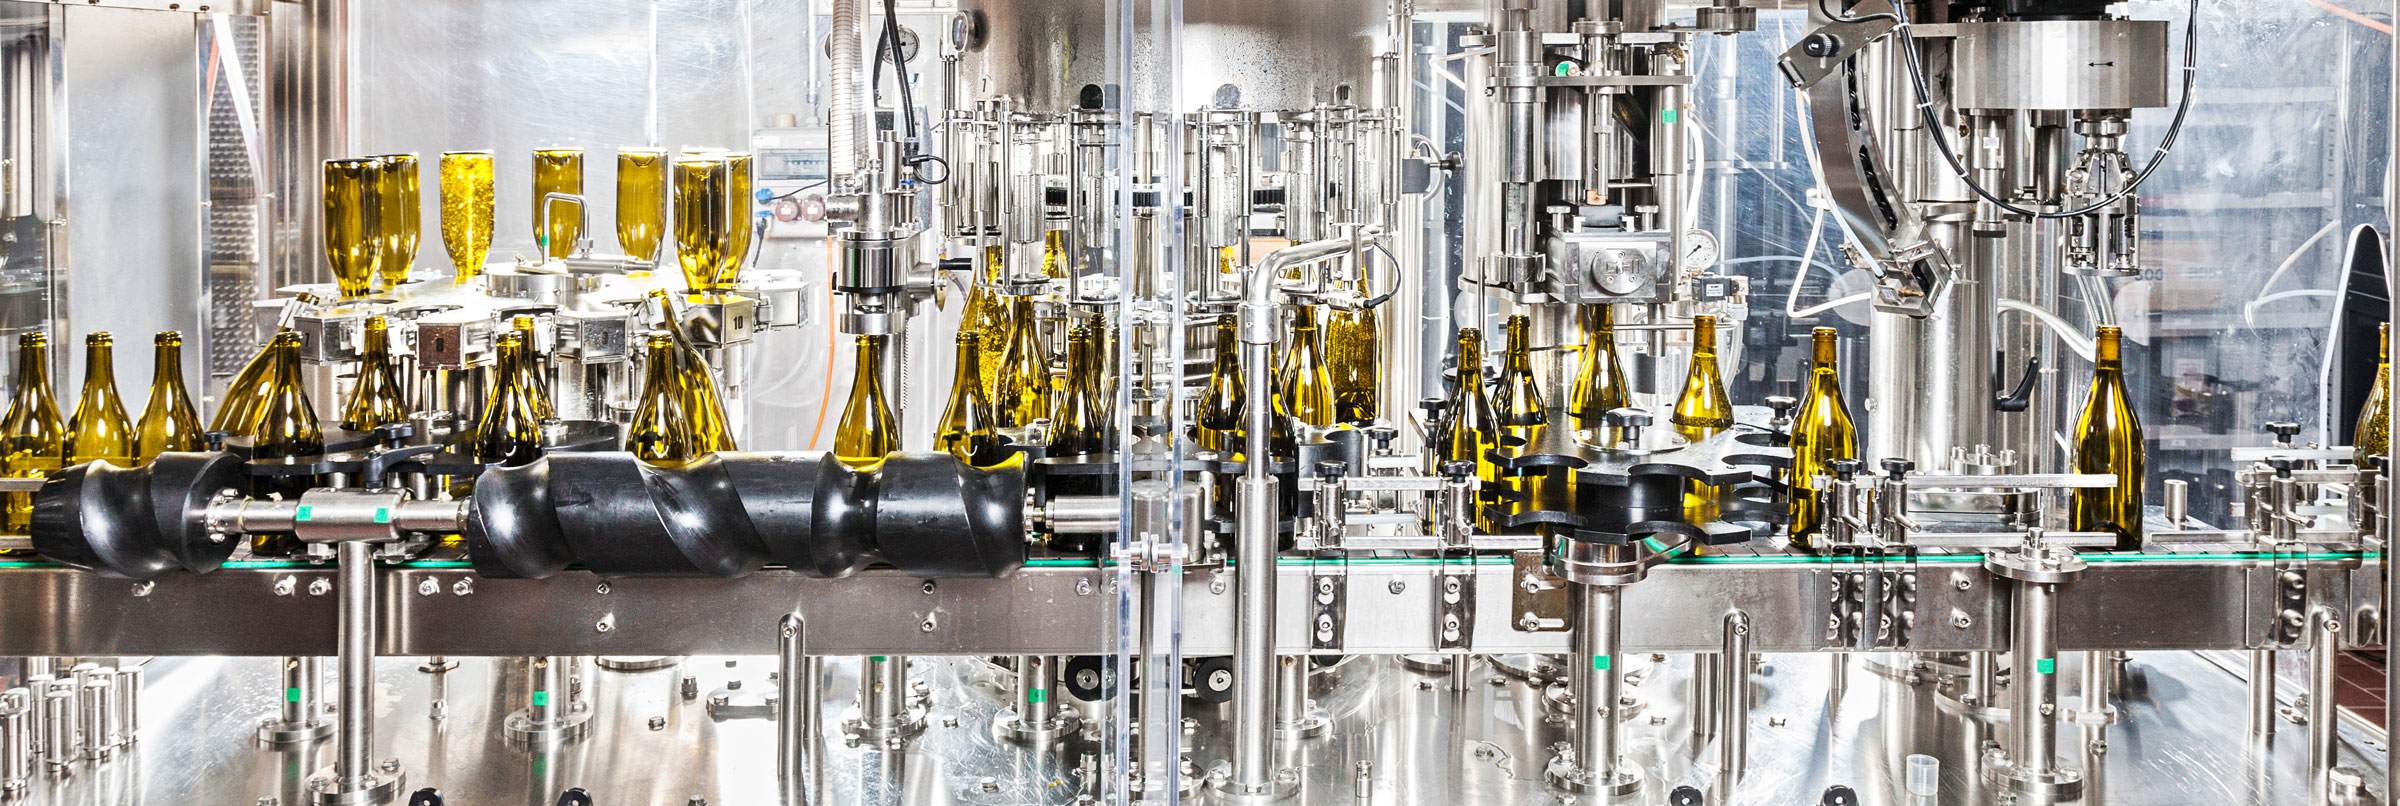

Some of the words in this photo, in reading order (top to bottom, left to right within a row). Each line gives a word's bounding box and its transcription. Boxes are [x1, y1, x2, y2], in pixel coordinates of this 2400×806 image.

[982, 78, 987, 92] 7
[1339, 85, 1349, 101] 10
[733, 315, 744, 330] 10
